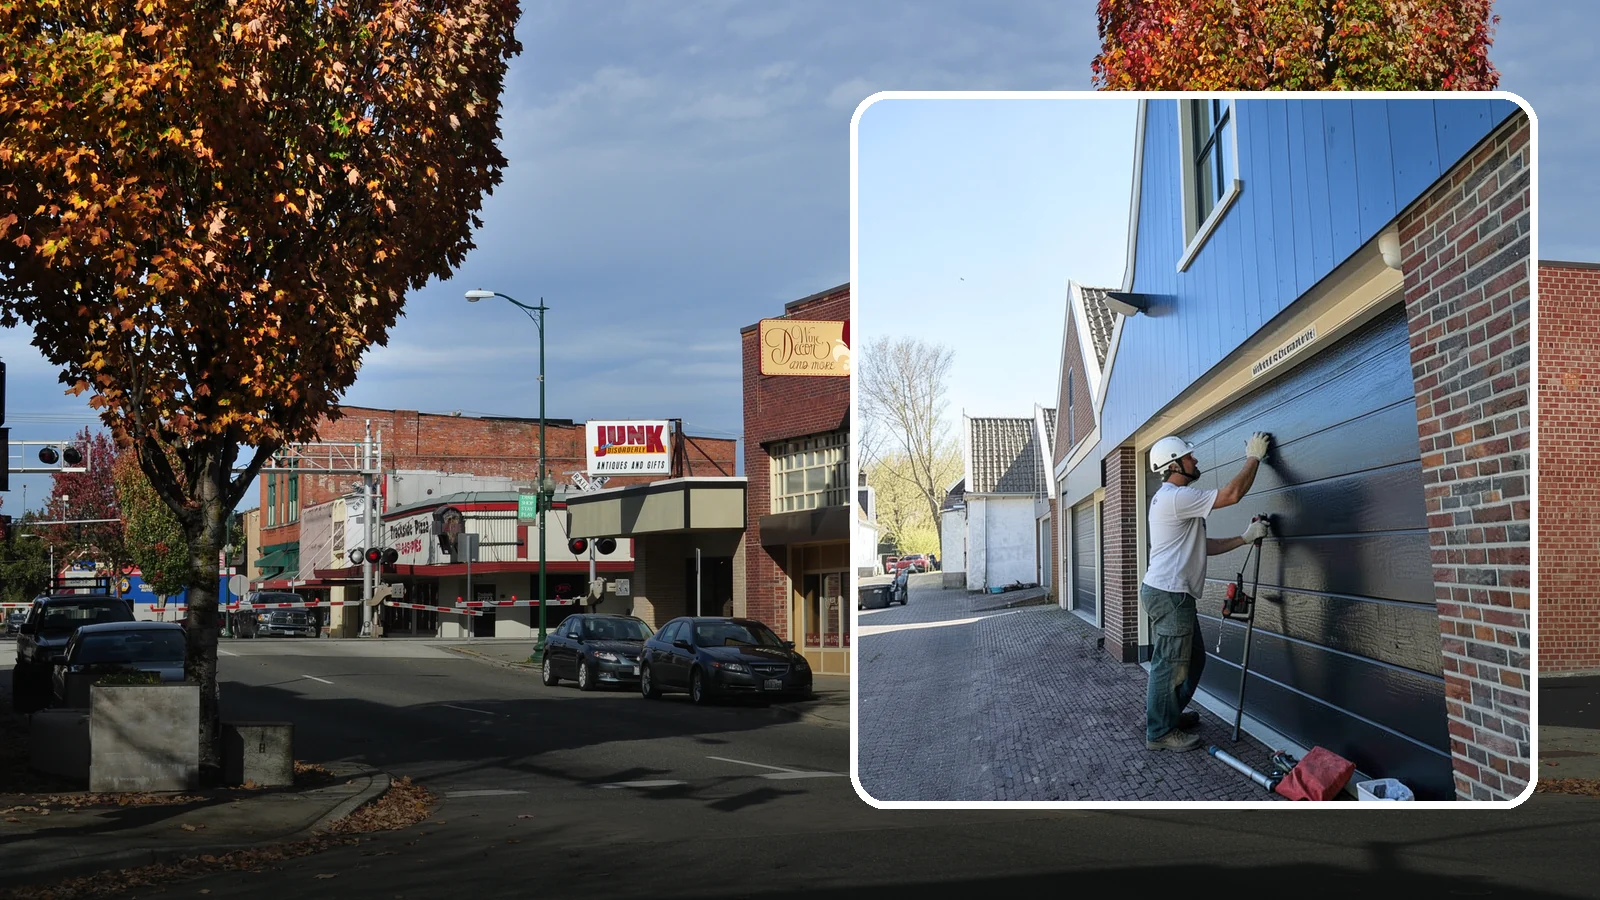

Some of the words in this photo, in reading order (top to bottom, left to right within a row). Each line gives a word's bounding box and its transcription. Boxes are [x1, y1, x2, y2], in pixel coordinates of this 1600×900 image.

[596, 425, 665, 457] JUNK
[607, 446, 646, 454] DISORDERLY
[597, 461, 628, 470] ANTIQUES
[631, 461, 644, 470] AND
[647, 461, 665, 470] GIFTS
[390, 521, 413, 539] Trackside
[415, 519, 429, 535] Pizza
